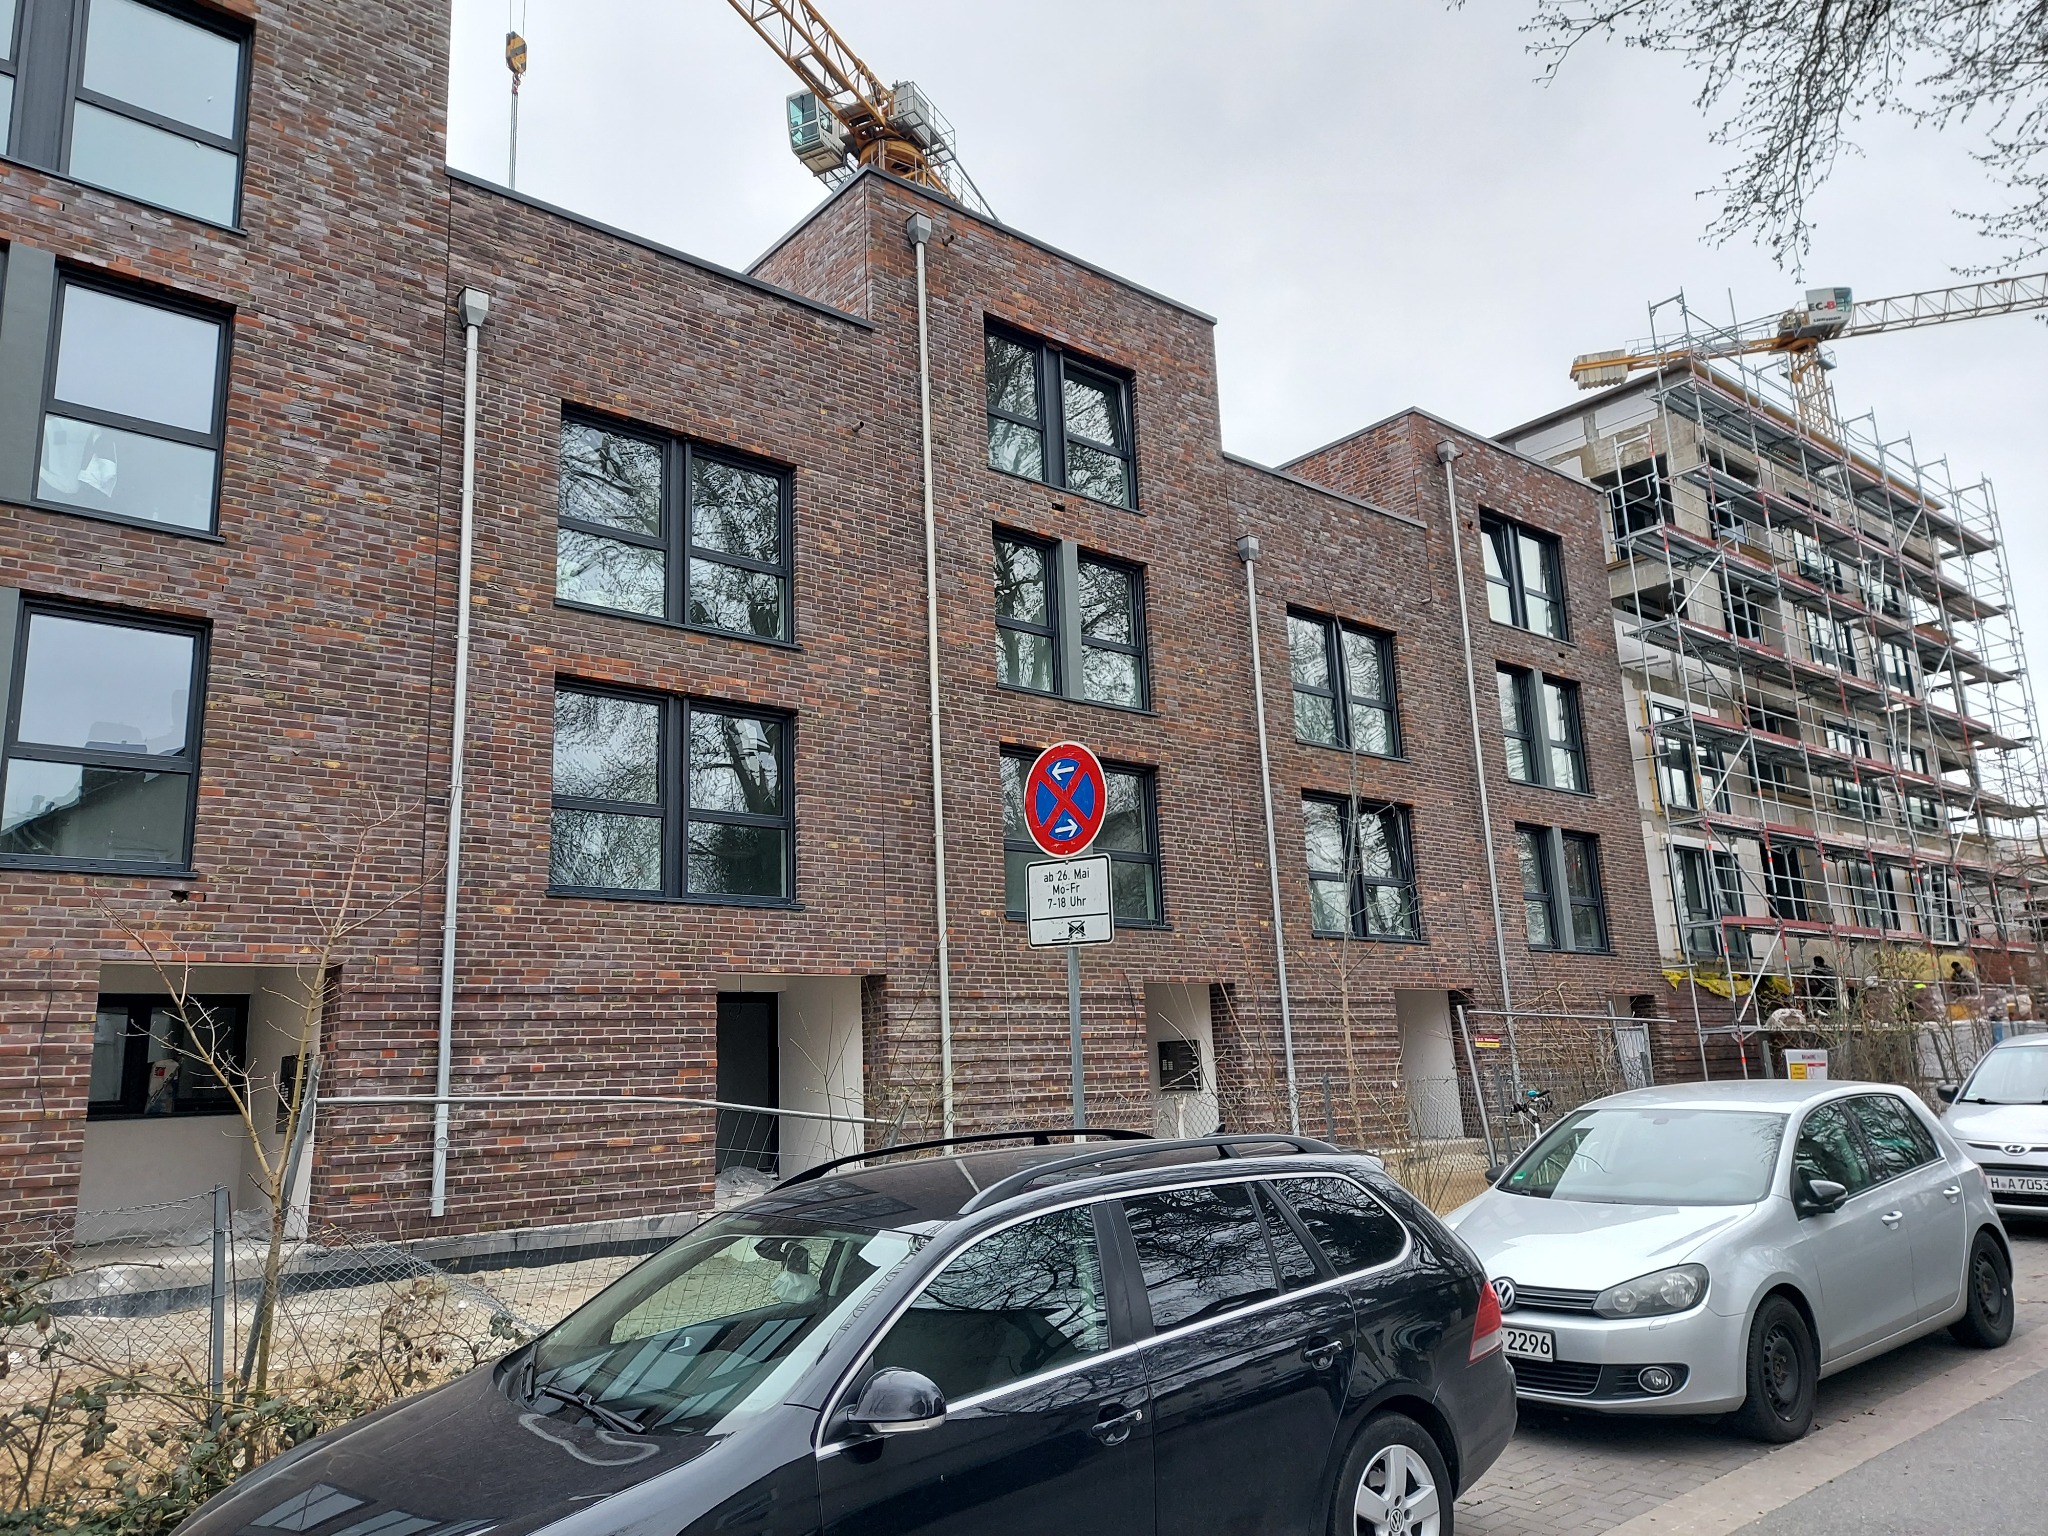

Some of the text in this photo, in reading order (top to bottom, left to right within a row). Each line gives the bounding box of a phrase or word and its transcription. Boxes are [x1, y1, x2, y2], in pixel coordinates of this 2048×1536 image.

[1043, 867, 1089, 883] ab 26. Mai
[1052, 882, 1081, 895] Mo-Fr
[1047, 895, 1087, 909] 7-18 Uhr
[1990, 1177, 2000, 1189] H
